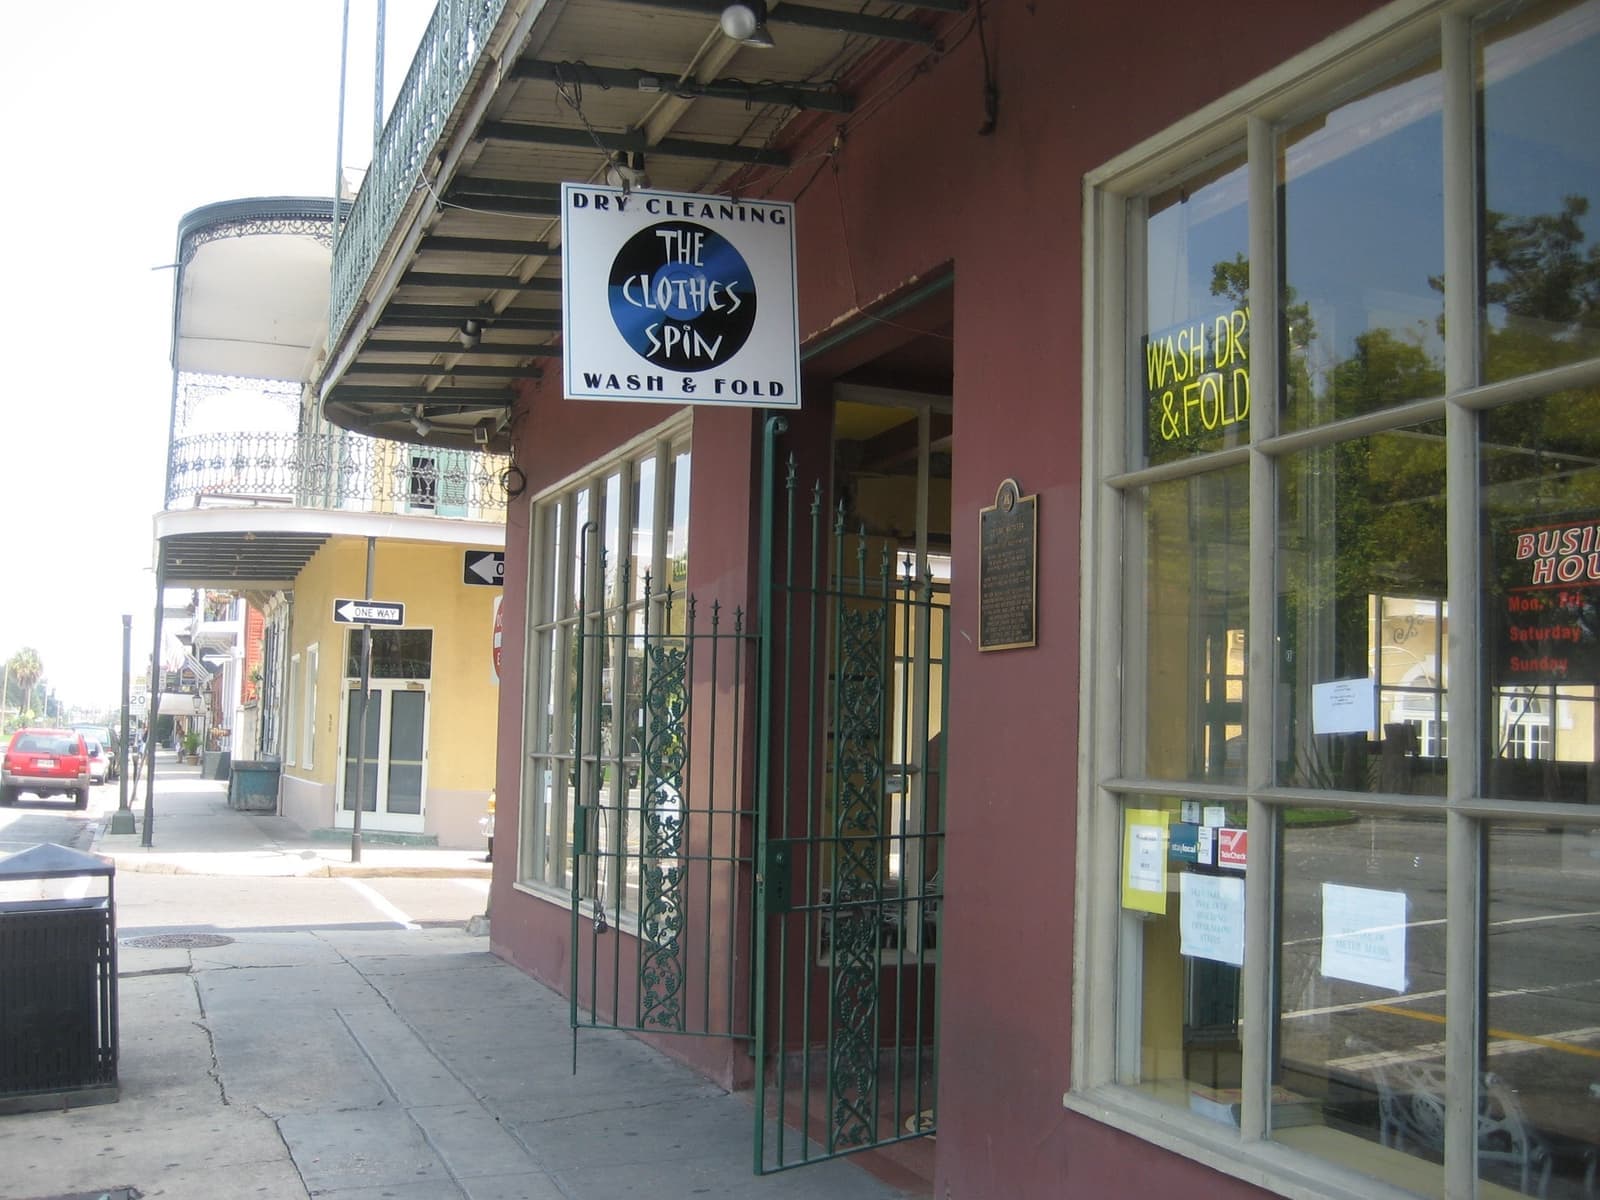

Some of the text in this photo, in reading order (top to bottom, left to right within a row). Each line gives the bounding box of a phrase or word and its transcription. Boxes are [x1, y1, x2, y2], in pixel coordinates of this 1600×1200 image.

[573, 193, 786, 225] DRY CLEANING
[656, 230, 704, 267] THE
[623, 274, 741, 315] CLOTHES
[1147, 322, 1204, 391] WASH
[583, 373, 784, 397] WASH & FOLD
[1161, 368, 1250, 440] & FOLD
[1516, 526, 1600, 560] BUSI
[354, 607, 397, 619] ONE WAY
[1509, 624, 1582, 643] Saturday
[1510, 656, 1569, 673] Sunday
[130, 695, 146, 705] 20
